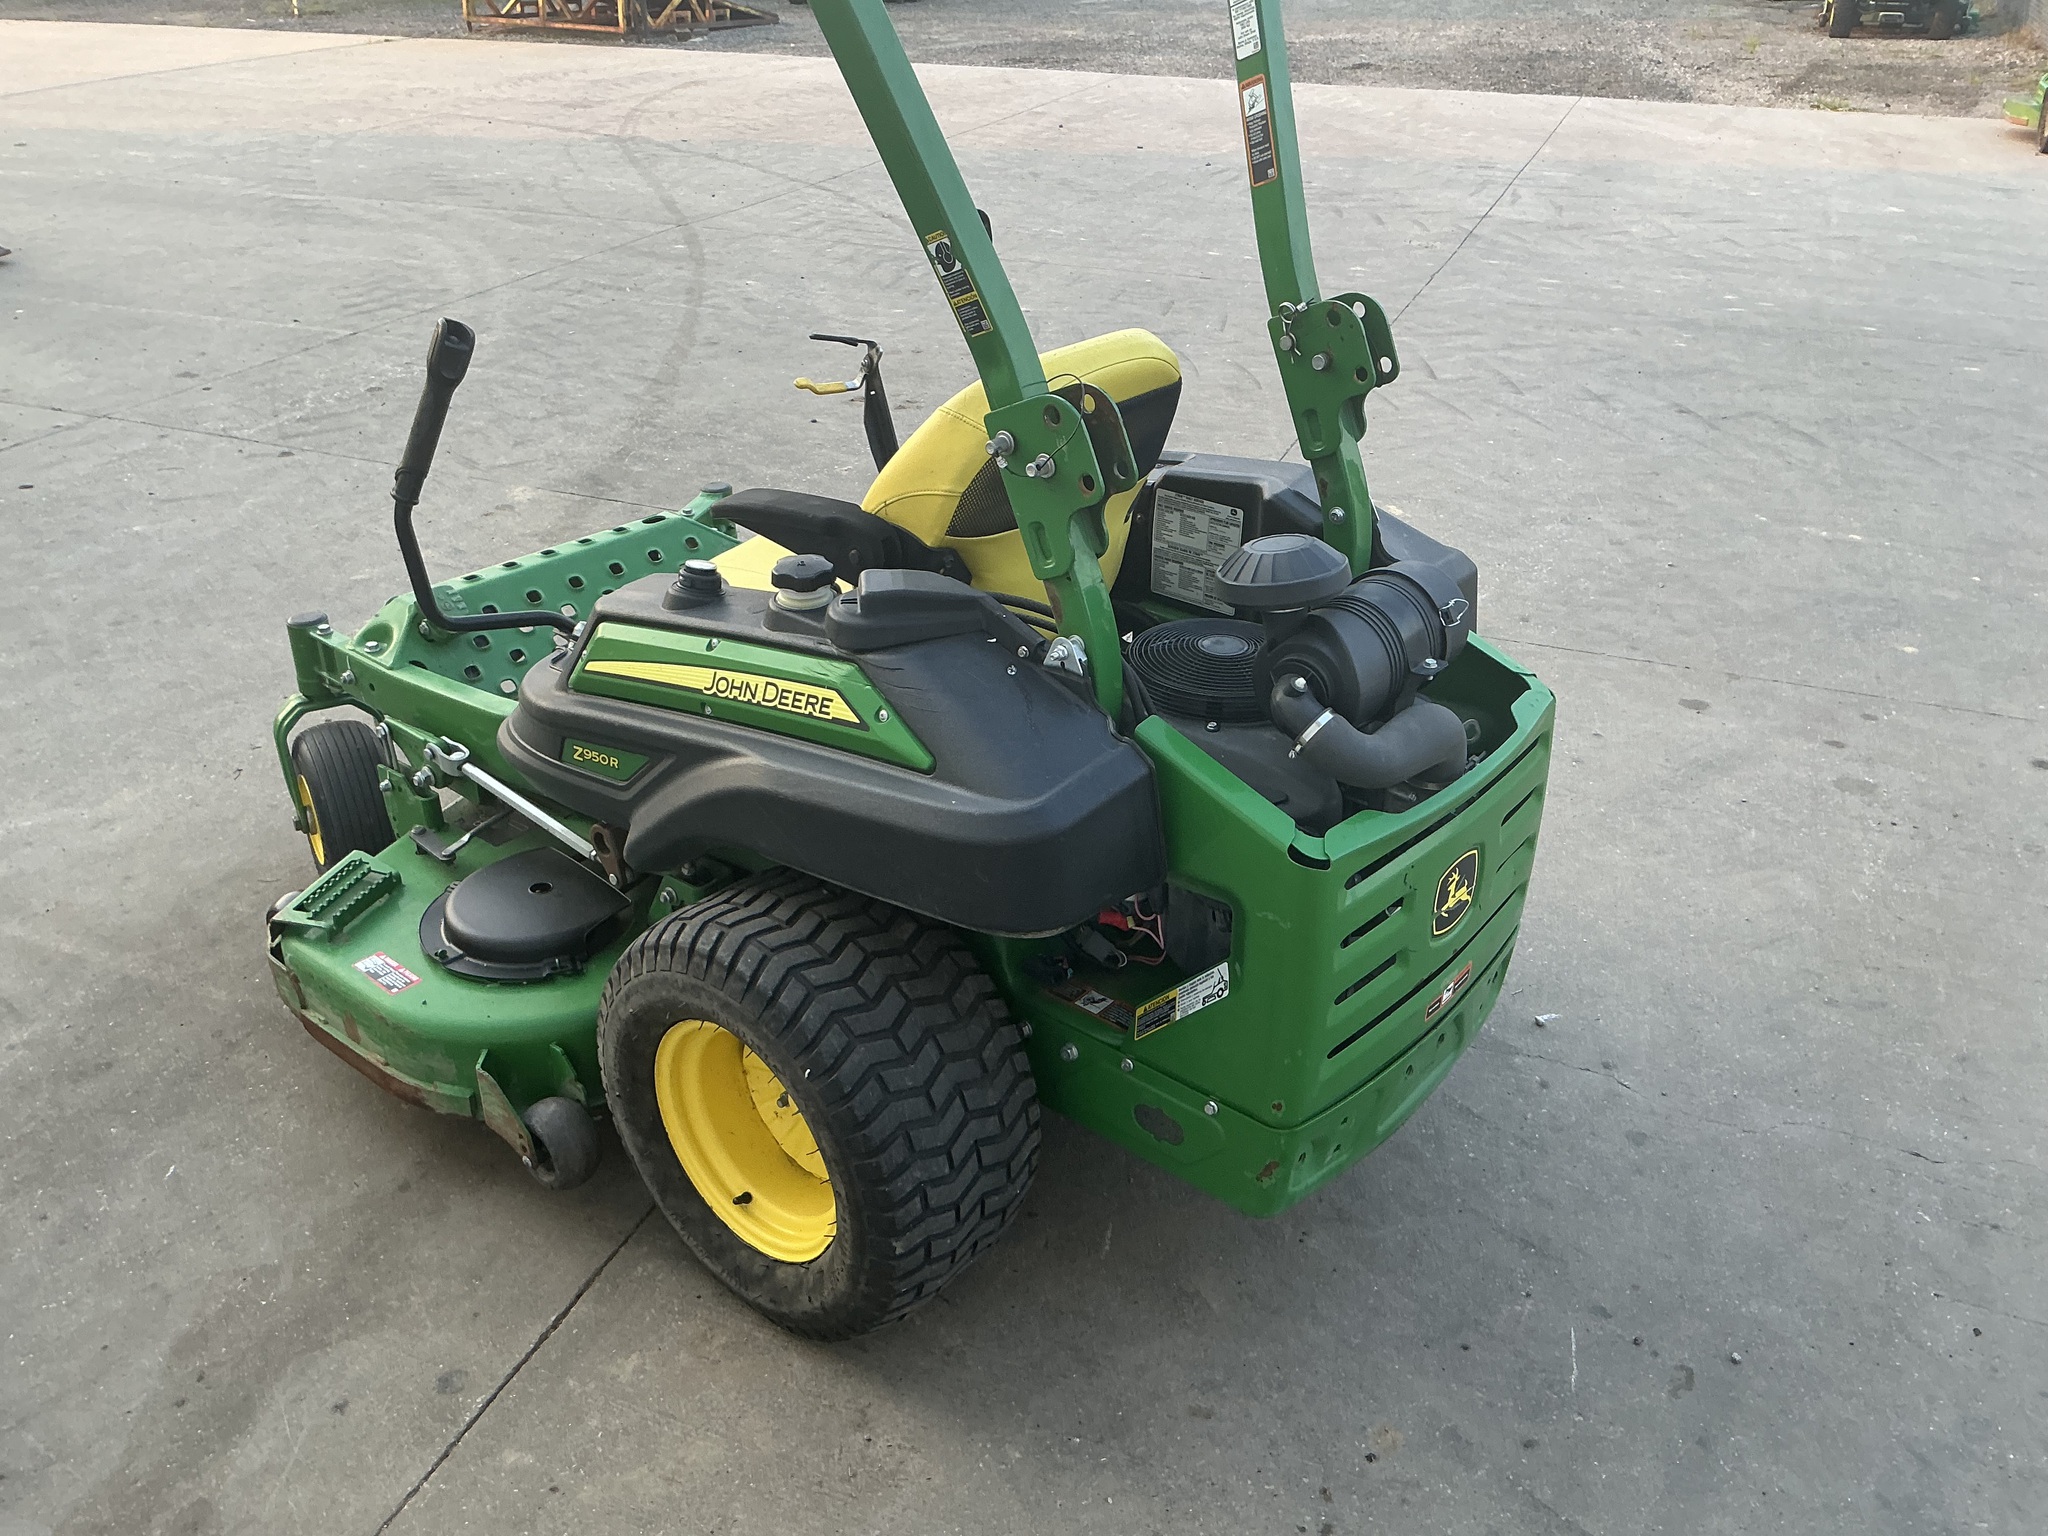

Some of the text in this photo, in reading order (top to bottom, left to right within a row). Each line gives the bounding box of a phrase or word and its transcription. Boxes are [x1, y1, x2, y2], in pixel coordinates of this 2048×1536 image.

[927, 231, 945, 241] CAUTIO
[703, 671, 834, 716] JOHN DEERE
[573, 745, 619, 769] Z950R
